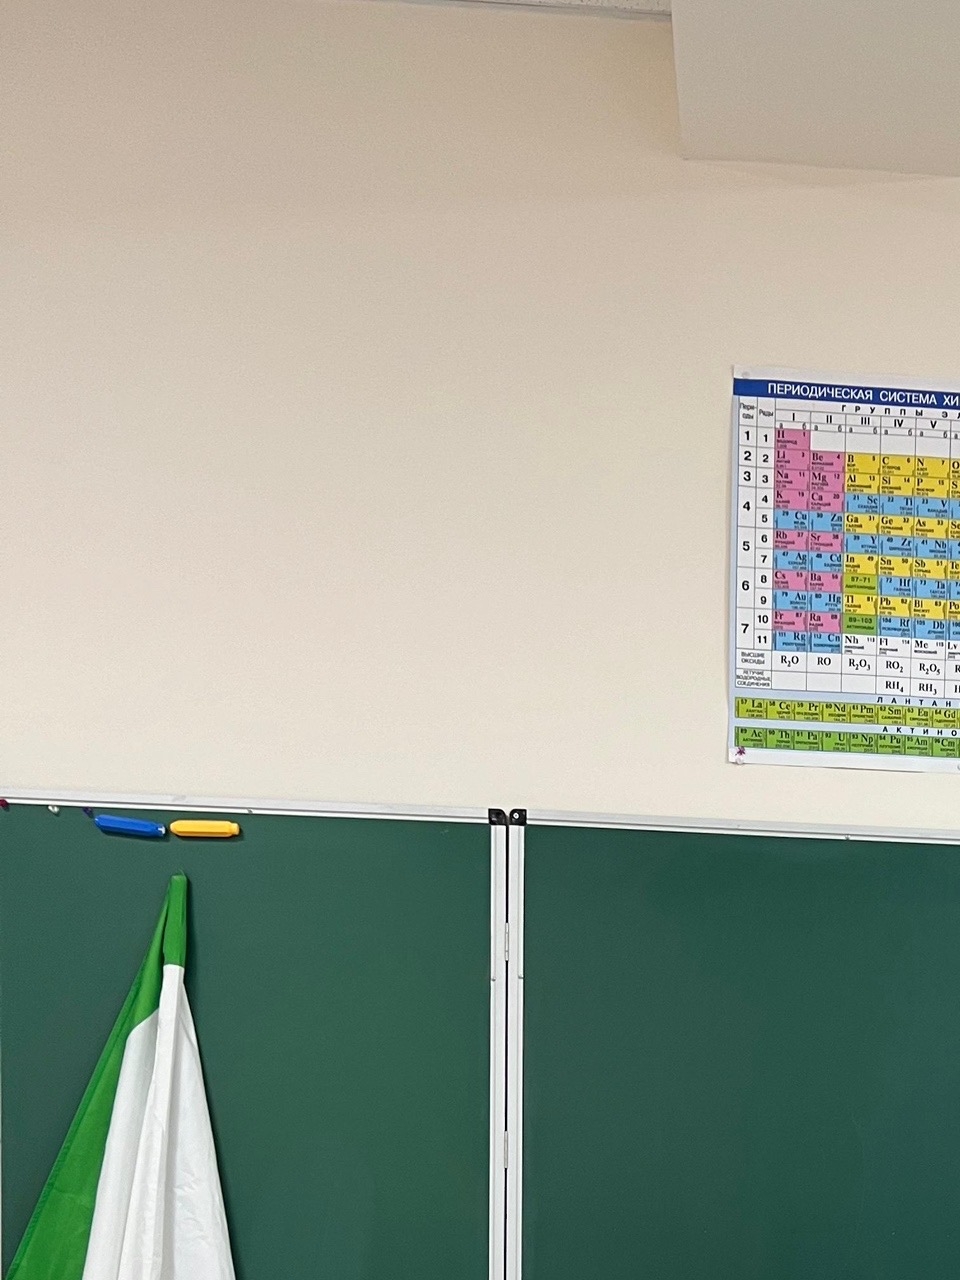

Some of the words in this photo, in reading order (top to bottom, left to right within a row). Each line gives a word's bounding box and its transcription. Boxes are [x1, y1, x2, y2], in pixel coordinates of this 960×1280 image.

[768, 382, 873, 400] ПЕРИОДИЧЕСКАЯ
[879, 390, 937, 405] СИСТЕМА
[745, 431, 750, 440] 1
[763, 434, 768, 442] 1
[744, 451, 751, 461] 2
[777, 451, 785, 459] Li
[812, 453, 823, 461] Be
[848, 454, 854, 463] B
[882, 457, 889, 465] C
[917, 458, 924, 466] N
[952, 461, 960, 469] O
[744, 471, 751, 481] 3
[776, 470, 788, 479] Na
[811, 472, 826, 482] Mg
[762, 475, 768, 483] 3
[882, 476, 891, 484] Si
[917, 478, 923, 486] P
[952, 481, 958, 489] S
[776, 490, 783, 499] K
[811, 493, 823, 501] Ca
[762, 495, 768, 503] 4
[743, 501, 751, 511] 4
[941, 500, 948, 508] V
[762, 514, 767, 522] 5
[846, 515, 859, 523] Ga
[881, 516, 893, 525] Ge
[916, 519, 926, 527] As
[951, 521, 960, 529] Se
[761, 535, 767, 543] 6
[775, 531, 787, 539] Rb
[811, 533, 820, 541] Sr
[871, 536, 877, 544] Y
[934, 540, 946, 548] Nb
[743, 541, 750, 551] 5
[761, 555, 767, 563] 7
[830, 554, 841, 562] Cd
[915, 559, 925, 568] Sb
[761, 575, 767, 583] 8
[742, 580, 749, 590] 6
[760, 596, 766, 604] 9
[757, 615, 768, 623] 10
[741, 623, 749, 634] 7
[757, 635, 767, 643] 11
[793, 632, 806, 642] Rg
[845, 636, 858, 644] Nh
[817, 657, 831, 666] RO
[752, 700, 762, 708] La
[808, 703, 818, 711] Pr
[834, 703, 846, 712] Nd
